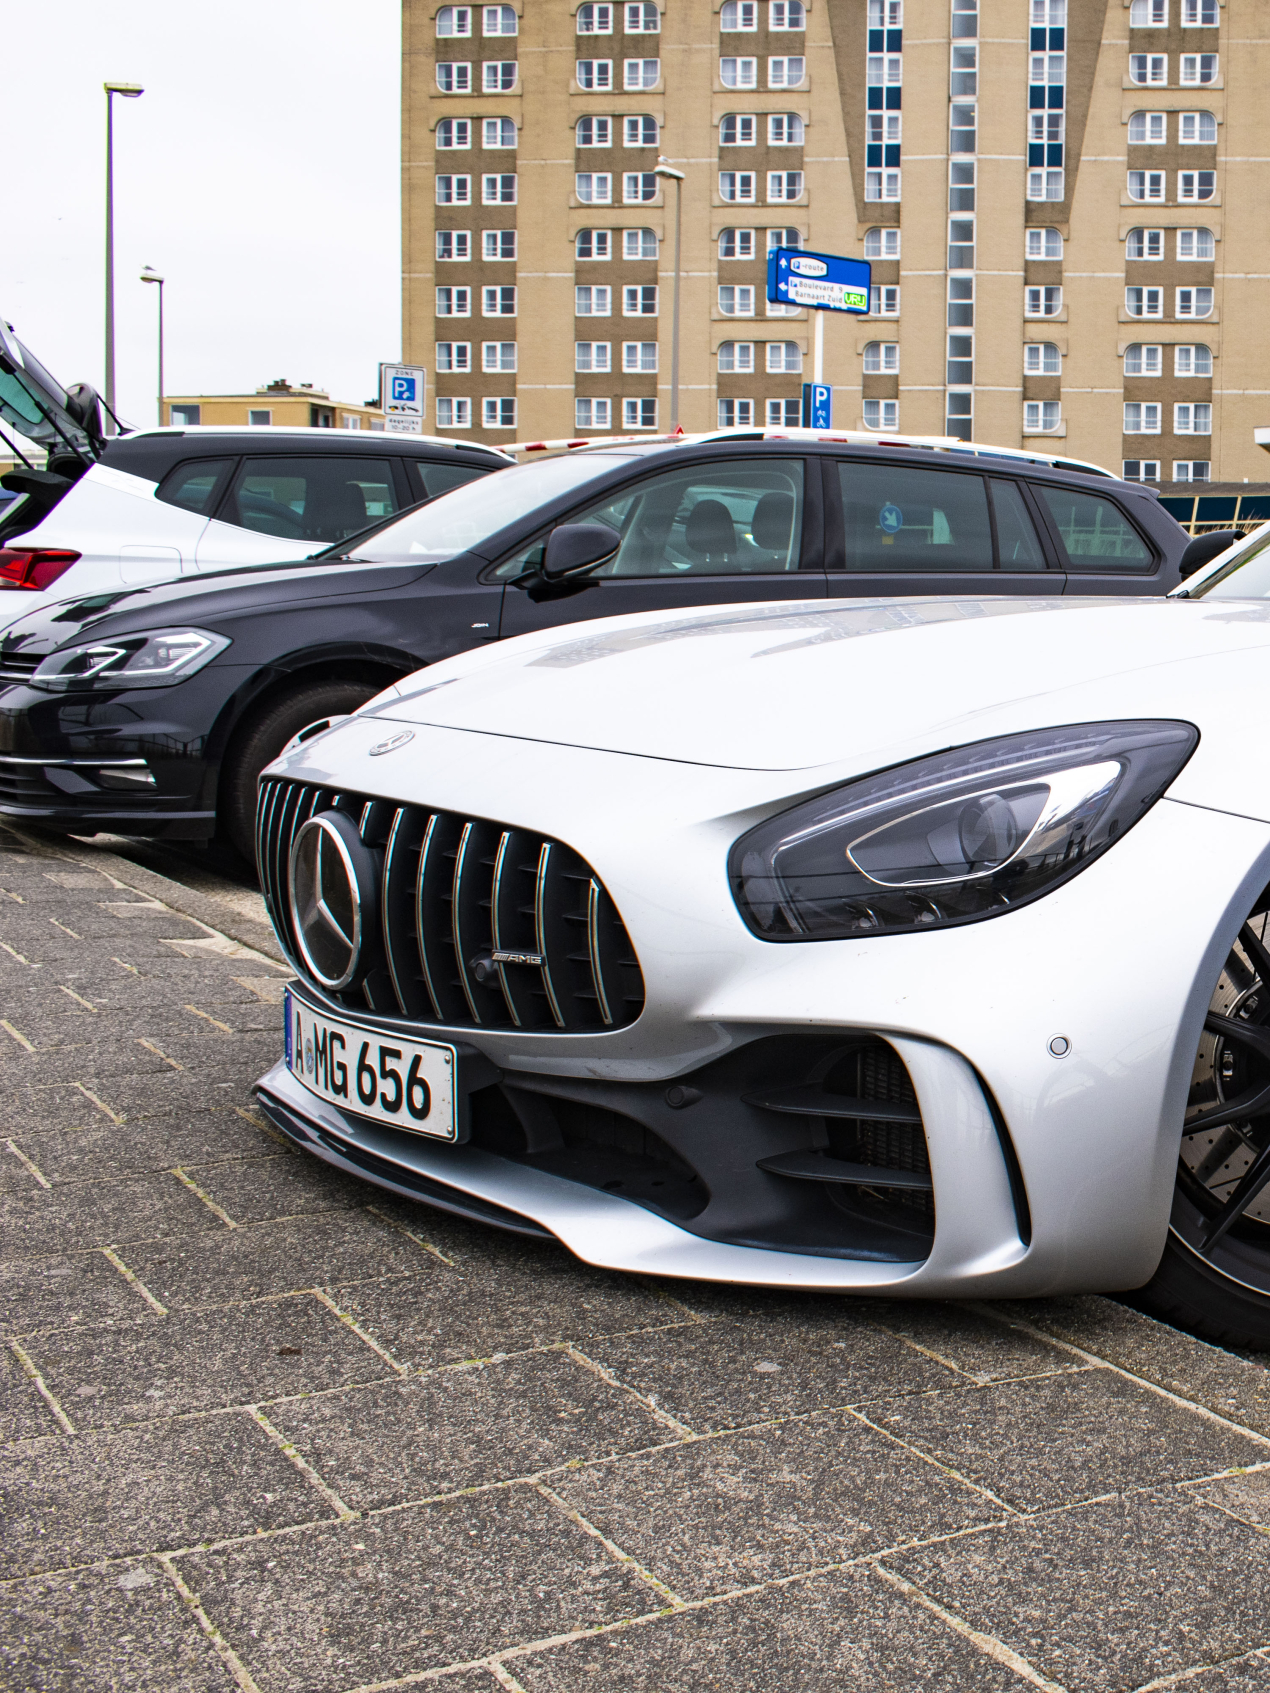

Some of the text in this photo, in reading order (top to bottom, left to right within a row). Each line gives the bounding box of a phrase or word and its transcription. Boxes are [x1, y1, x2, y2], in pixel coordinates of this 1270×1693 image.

[799, 280, 834, 293] Boulevard
[795, 290, 843, 304] Barnaart Zuid
[395, 369, 414, 377] ZONE
[394, 379, 408, 398] P
[815, 386, 828, 408] P
[389, 418, 419, 426] dagelijks
[507, 954, 542, 965] AMG
[296, 1010, 432, 1121] A MG 656
